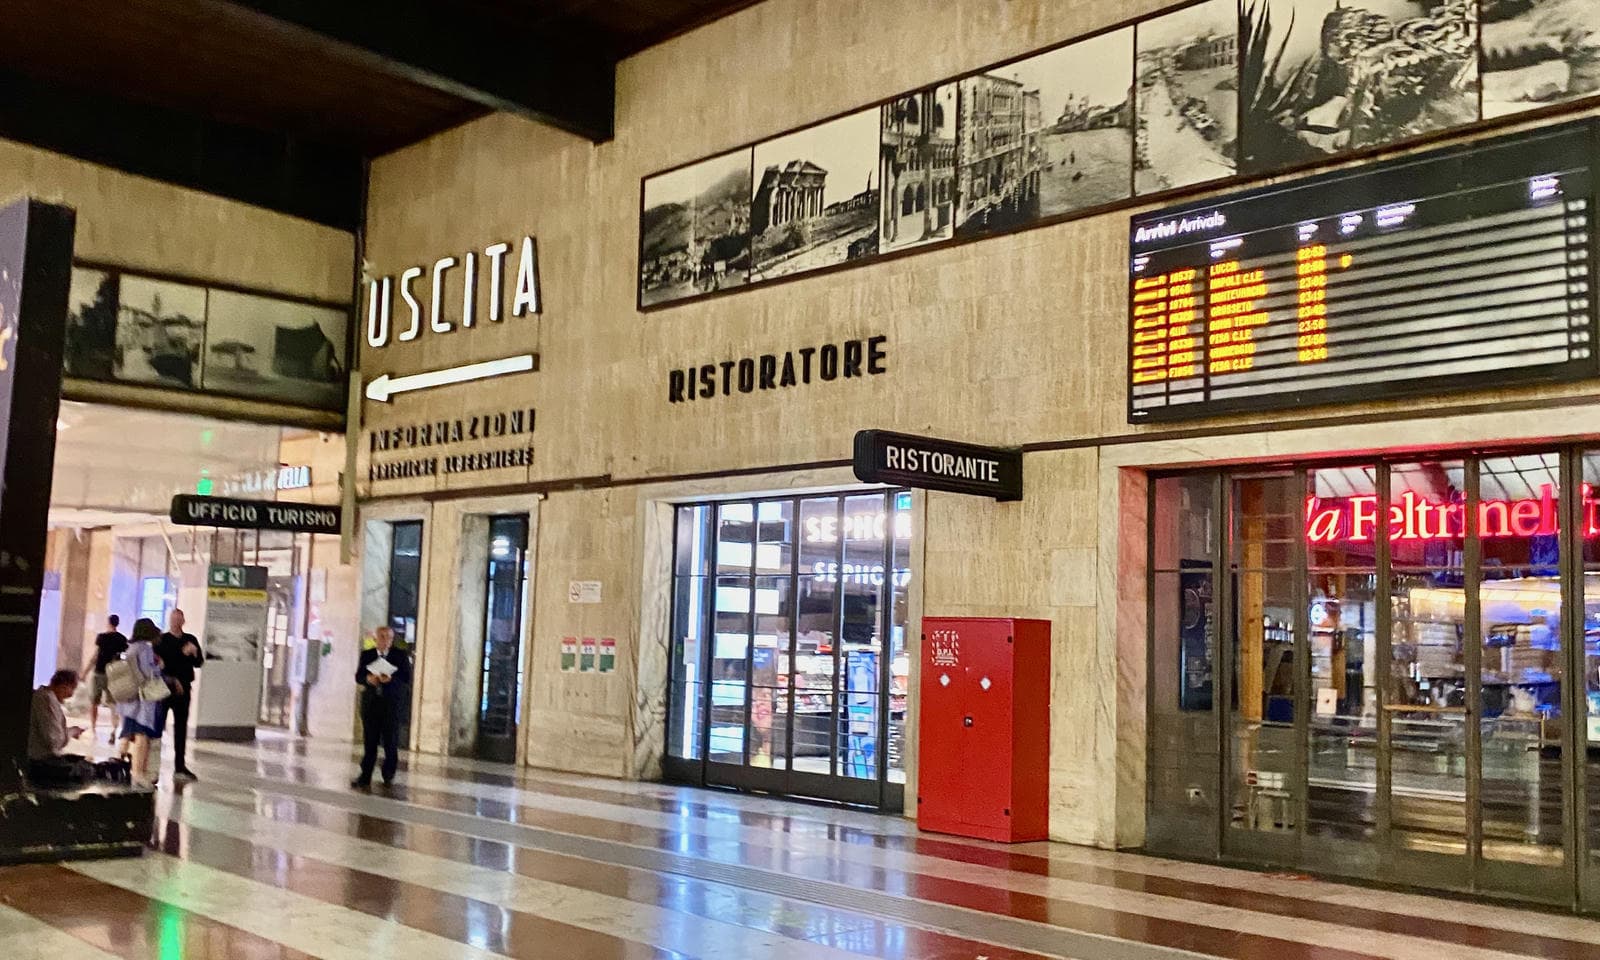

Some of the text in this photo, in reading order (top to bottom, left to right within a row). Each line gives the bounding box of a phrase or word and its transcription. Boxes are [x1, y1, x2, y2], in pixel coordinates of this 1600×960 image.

[1178, 210, 1226, 233] Arrivals
[368, 236, 537, 347] USCITA
[669, 335, 887, 403] RISTORATORE
[370, 408, 536, 451] INFORMAZIONI
[443, 447, 534, 473] ALBERGHIERE
[886, 445, 999, 482] RISTORANTE
[188, 502, 337, 527] UFFICIO TURISMO
[1348, 483, 1589, 541] Feltrinel
